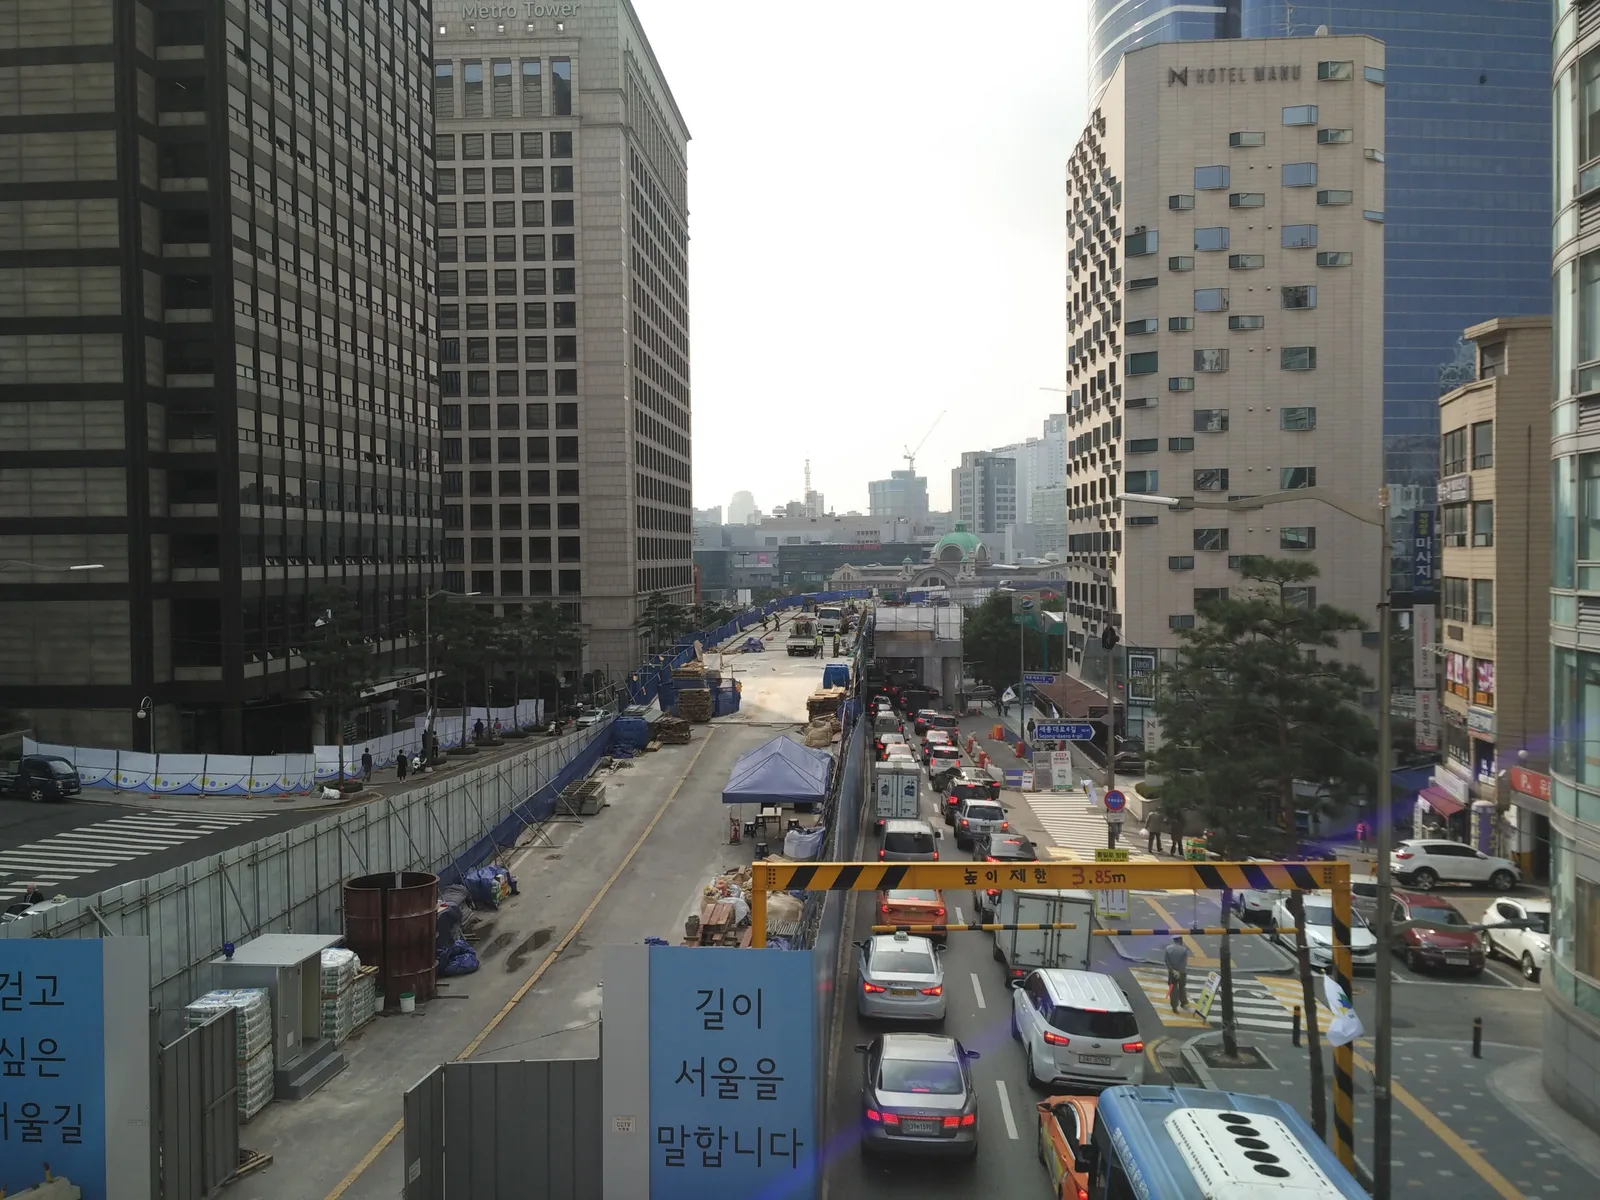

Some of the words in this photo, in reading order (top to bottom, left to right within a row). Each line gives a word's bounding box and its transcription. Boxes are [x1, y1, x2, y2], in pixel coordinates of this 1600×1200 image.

[462, 3, 517, 20] Metro
[523, 1, 581, 18] Tower
[1197, 68, 1246, 84] HOTEL
[1254, 65, 1301, 82] MANU
[1416, 536, 1433, 579] 마사지
[1039, 725, 1077, 734] 세종대로4길
[964, 868, 998, 885] 높이
[1009, 868, 1048, 884] 제한
[1072, 865, 1127, 886] 3.85m
[0, 971, 65, 1012] 걷고
[695, 988, 762, 1031] 길이
[0, 1037, 66, 1078] 싶은
[674, 1056, 784, 1101] 서울을
[657, 1124, 804, 1169] 말합니다
